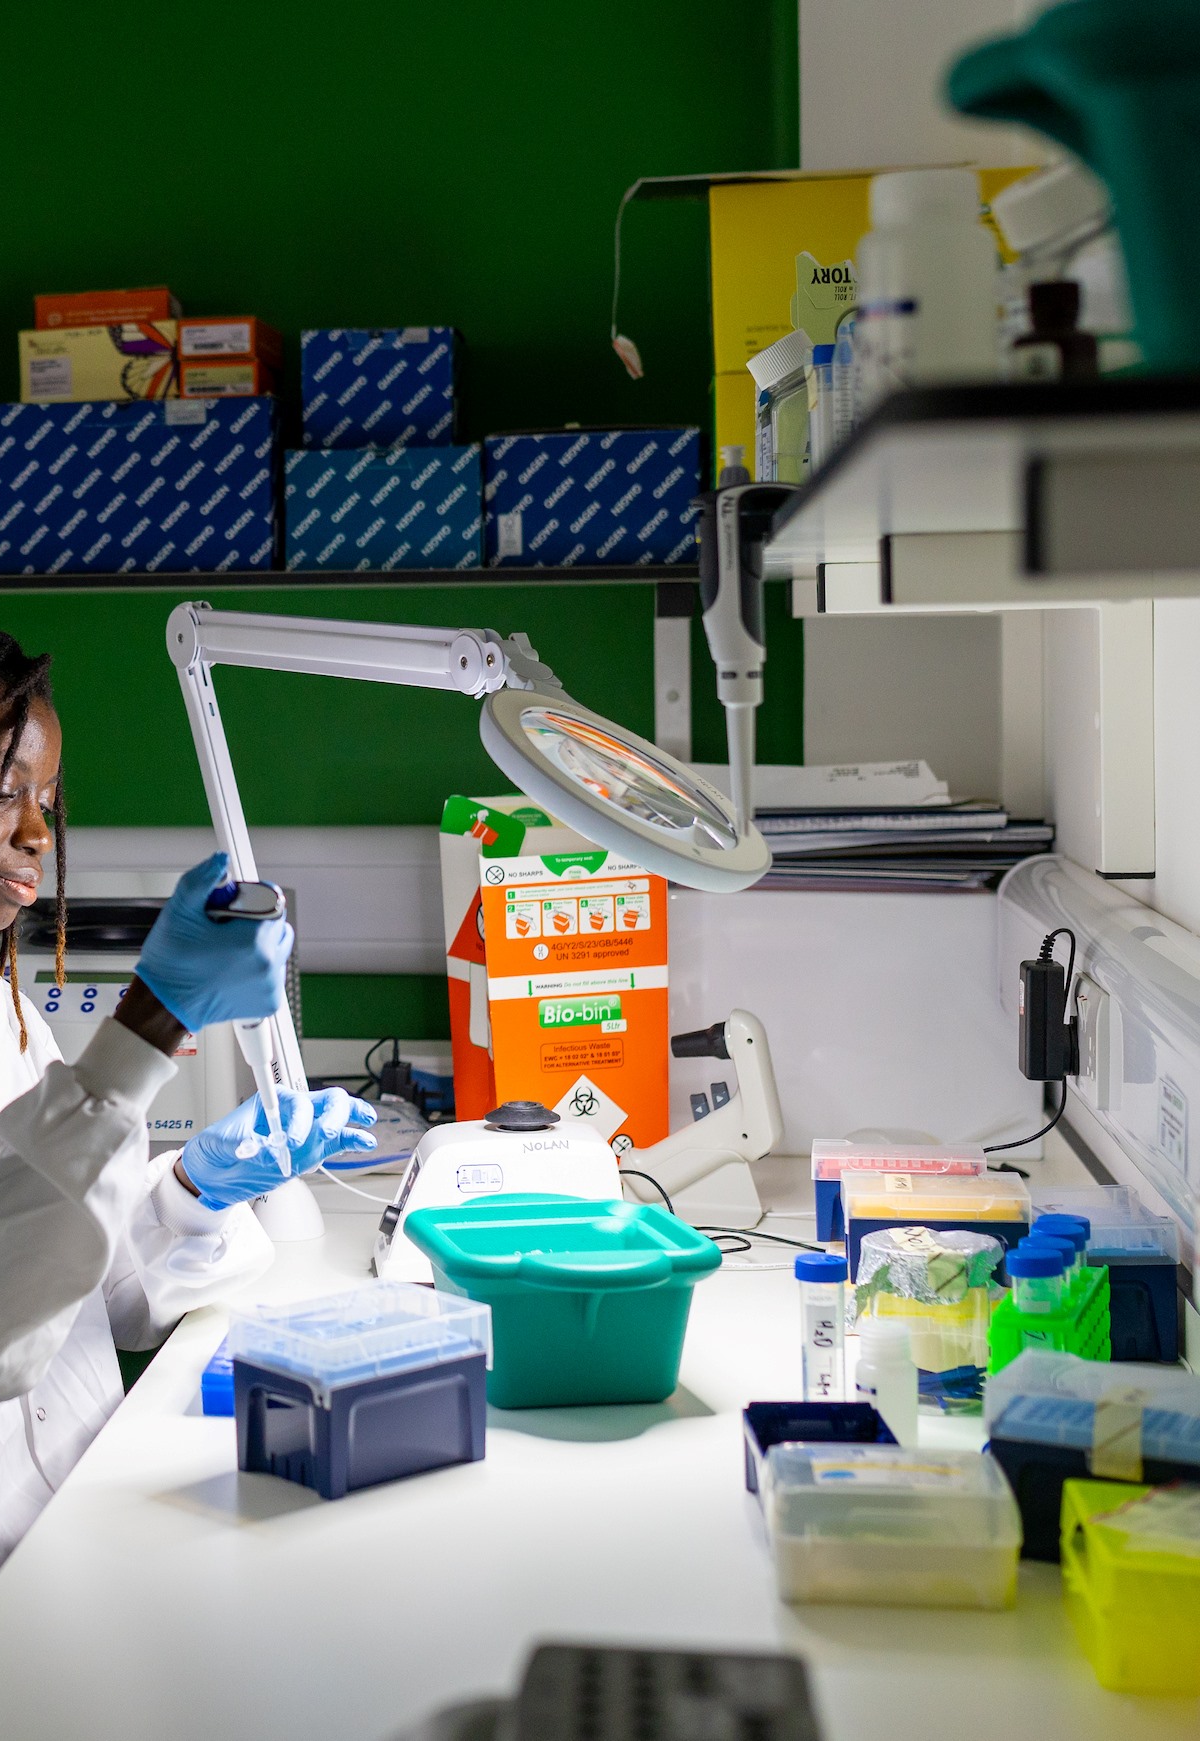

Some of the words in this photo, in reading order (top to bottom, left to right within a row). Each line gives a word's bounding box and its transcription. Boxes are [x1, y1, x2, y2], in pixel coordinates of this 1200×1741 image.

[313, 351, 343, 382] QIAGEN
[353, 338, 383, 366] QIAGEN
[417, 344, 448, 374] QIAGEN
[377, 360, 407, 390] QIAGEN
[337, 376, 367, 406] QIAGEN
[402, 384, 432, 415] QIAGEN
[63, 404, 92, 434] QIAGEN
[126, 412, 156, 442] QIAGEN
[230, 403, 260, 434] QIAGEN
[362, 400, 392, 431] QIAGEN
[24, 420, 54, 451] QIAGEN
[87, 428, 117, 458] QIAGEN
[189, 420, 220, 450] QIAGEN
[558, 434, 589, 467] QIAGEN
[48, 444, 78, 475] QIAGEN
[150, 436, 180, 466] QIAGEN
[214, 444, 244, 475] QIAGEN
[345, 450, 375, 482] QIAGEN
[451, 443, 480, 474] QIAGEN
[626, 441, 658, 474] QIAGEN
[10, 461, 39, 491] QIAGEN
[111, 452, 141, 483] QIAGEN
[175, 460, 205, 491] QIAGEN
[306, 468, 336, 498] QIAGEN
[411, 459, 441, 490] QIAGEN
[518, 452, 549, 484] QIAGEN
[584, 459, 615, 492] QIAGEN
[653, 466, 684, 499] QIAGEN
[73, 468, 102, 499] QIAGEN
[135, 476, 165, 507] QIAGEN
[239, 468, 270, 499] QIAGEN
[370, 476, 400, 507] QIAGEN
[544, 477, 574, 509] QIAGEN
[34, 485, 63, 515] QIAGEN
[97, 493, 126, 523] QIAGEN
[200, 485, 230, 515] QIAGEN
[331, 493, 361, 523] QIAGEN
[436, 484, 466, 515] QIAGEN
[610, 484, 642, 516] QIAGEN
[58, 509, 87, 539] QIAGEN
[121, 517, 151, 547] QIAGEN
[160, 501, 190, 532] QIAGEN
[225, 509, 254, 540] QIAGEN
[291, 509, 321, 539] QIAGEN
[356, 517, 386, 547] QIAGEN
[395, 501, 425, 532] QIAGEN
[570, 502, 601, 533] QIAGEN
[637, 509, 668, 541] QIAGEN
[20, 525, 49, 555] QIAGEN
[82, 533, 111, 563] QIAGEN
[185, 525, 215, 556] QIAGEN
[316, 533, 345, 564] QIAGEN
[421, 525, 451, 556] QIAGEN
[529, 519, 559, 550] QIAGEN
[596, 526, 627, 558] QIAGEN
[146, 542, 175, 572] QIAGEN
[556, 953, 569, 961] UN
[571, 951, 591, 960] 3291
[593, 949, 630, 960] approved
[553, 1043, 587, 1053] Infectious
[588, 1042, 611, 1050] Waste
[555, 1060, 591, 1069] ALTERNATIVE
[591, 1058, 622, 1066] TREATMENT
[155, 1120, 182, 1129] 5425
[185, 1120, 193, 1129] R
[522, 1140, 569, 1154] NOLAN
